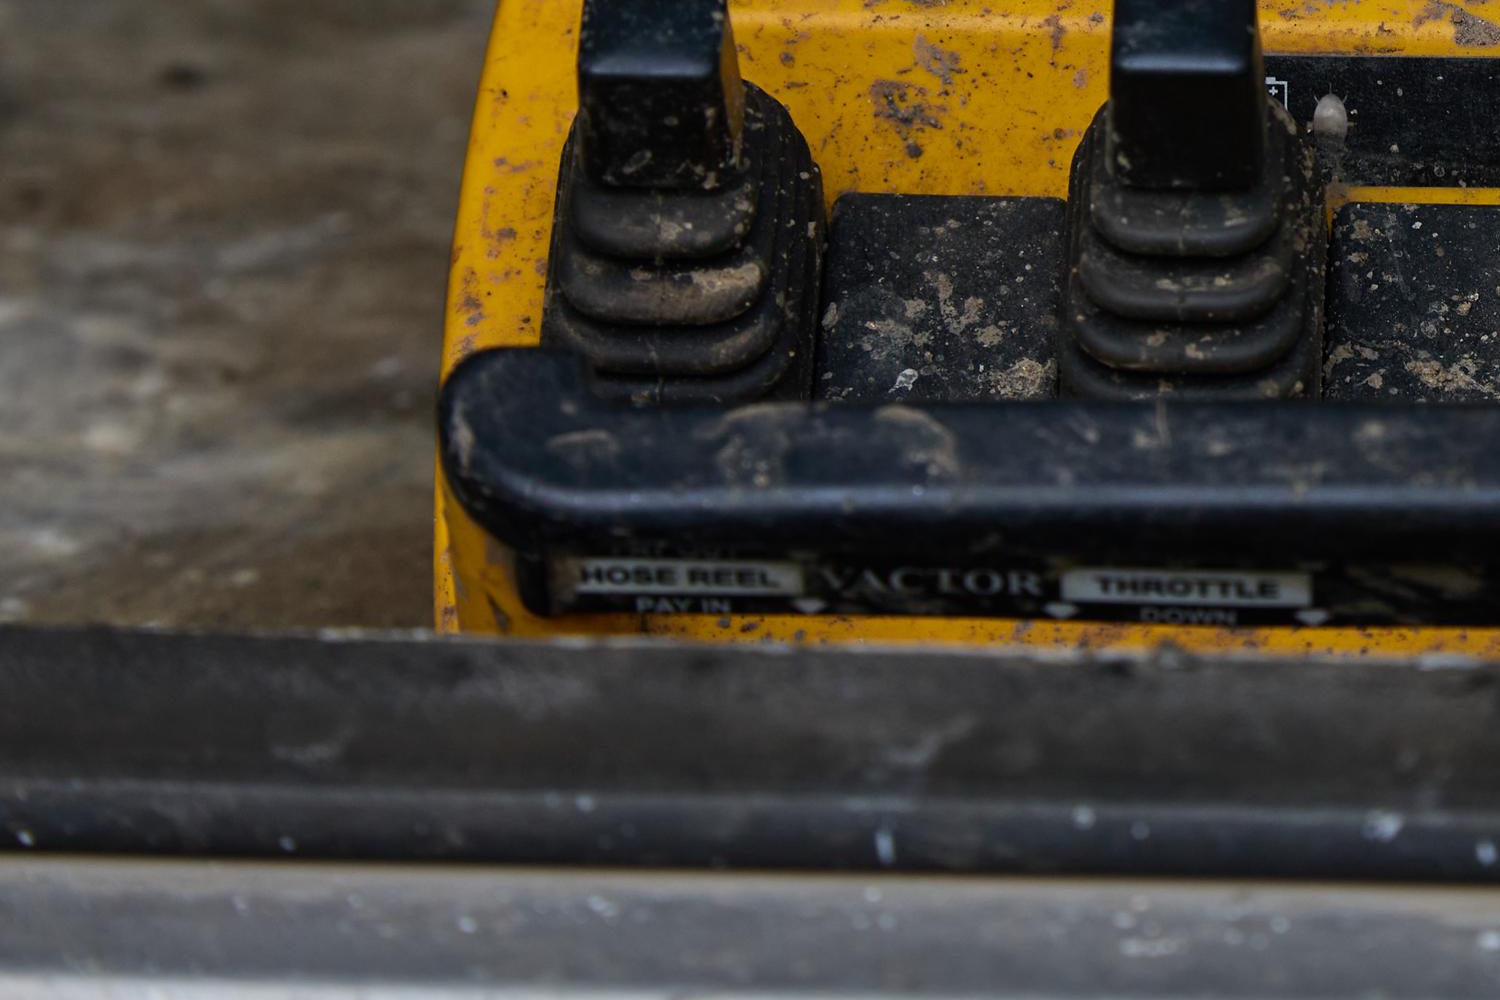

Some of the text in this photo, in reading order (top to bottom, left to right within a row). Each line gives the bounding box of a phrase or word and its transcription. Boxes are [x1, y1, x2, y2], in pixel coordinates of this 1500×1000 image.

[580, 565, 781, 587] HOSE REEL
[1096, 576, 1281, 599] THROTTLE
[635, 598, 690, 613] PAY
[1139, 606, 1240, 626] DOWN
